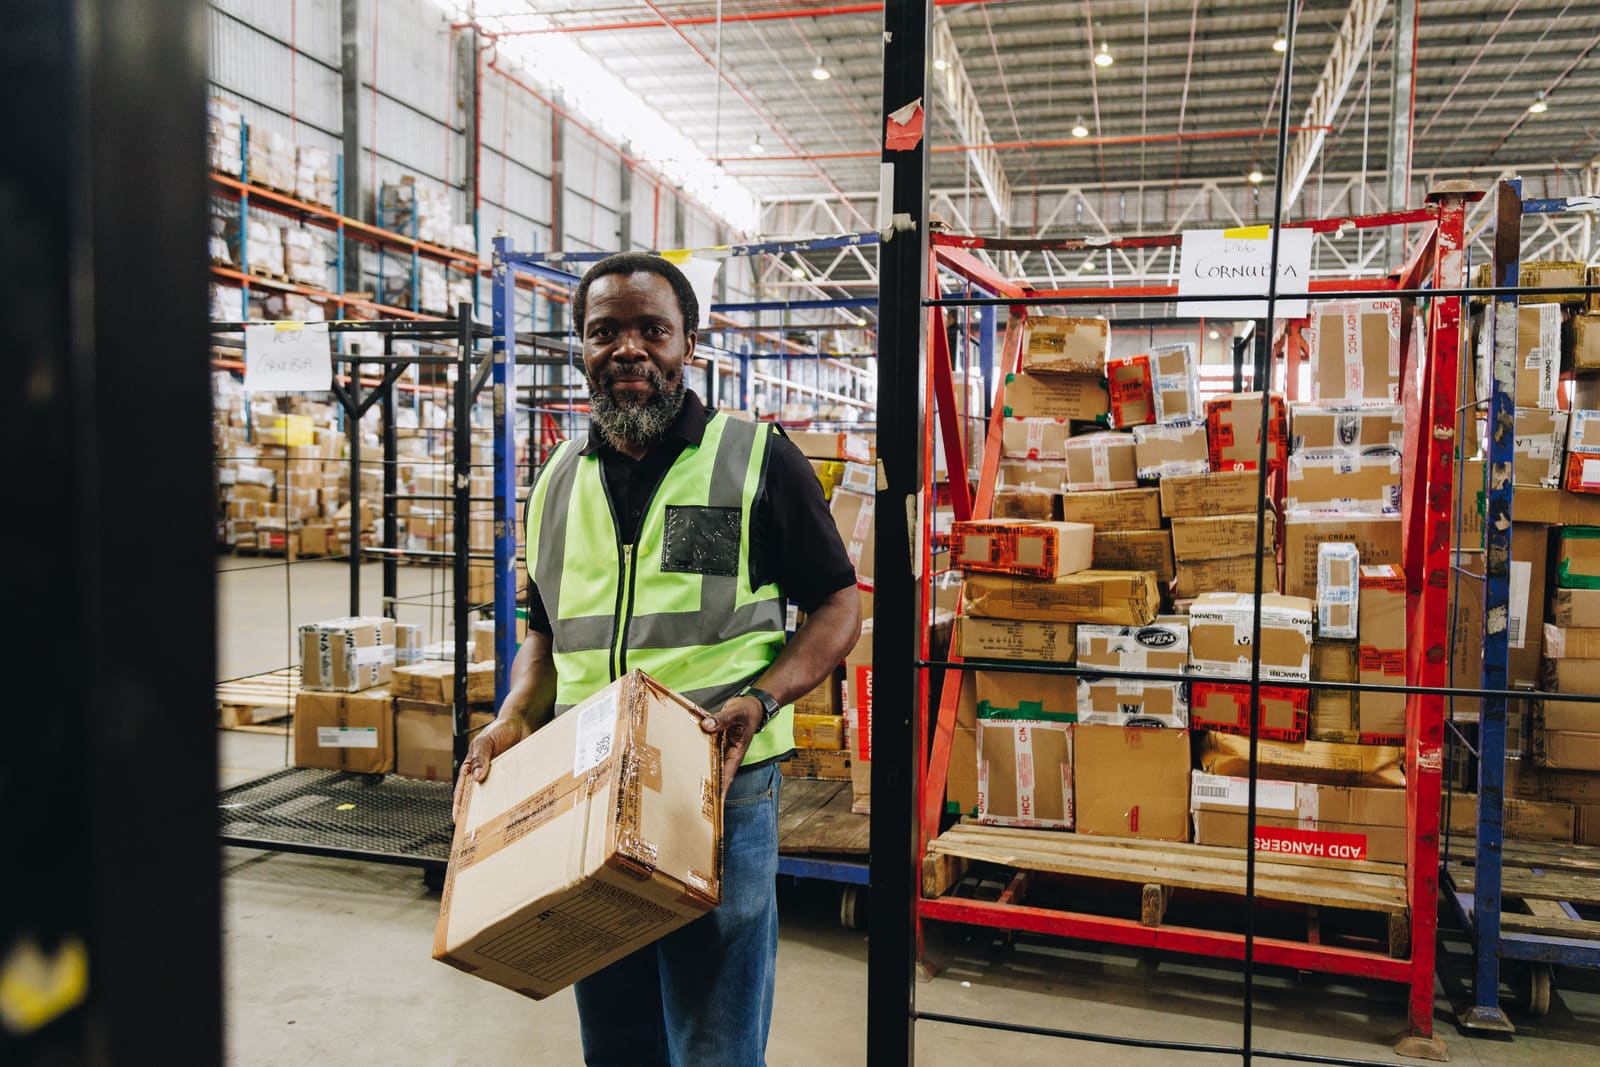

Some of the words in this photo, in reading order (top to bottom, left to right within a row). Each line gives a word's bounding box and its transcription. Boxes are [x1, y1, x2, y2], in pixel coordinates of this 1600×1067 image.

[1021, 795, 1030, 815] HCC
[1254, 838, 1324, 855] HANGERS
[1329, 844, 1361, 858] ADD
